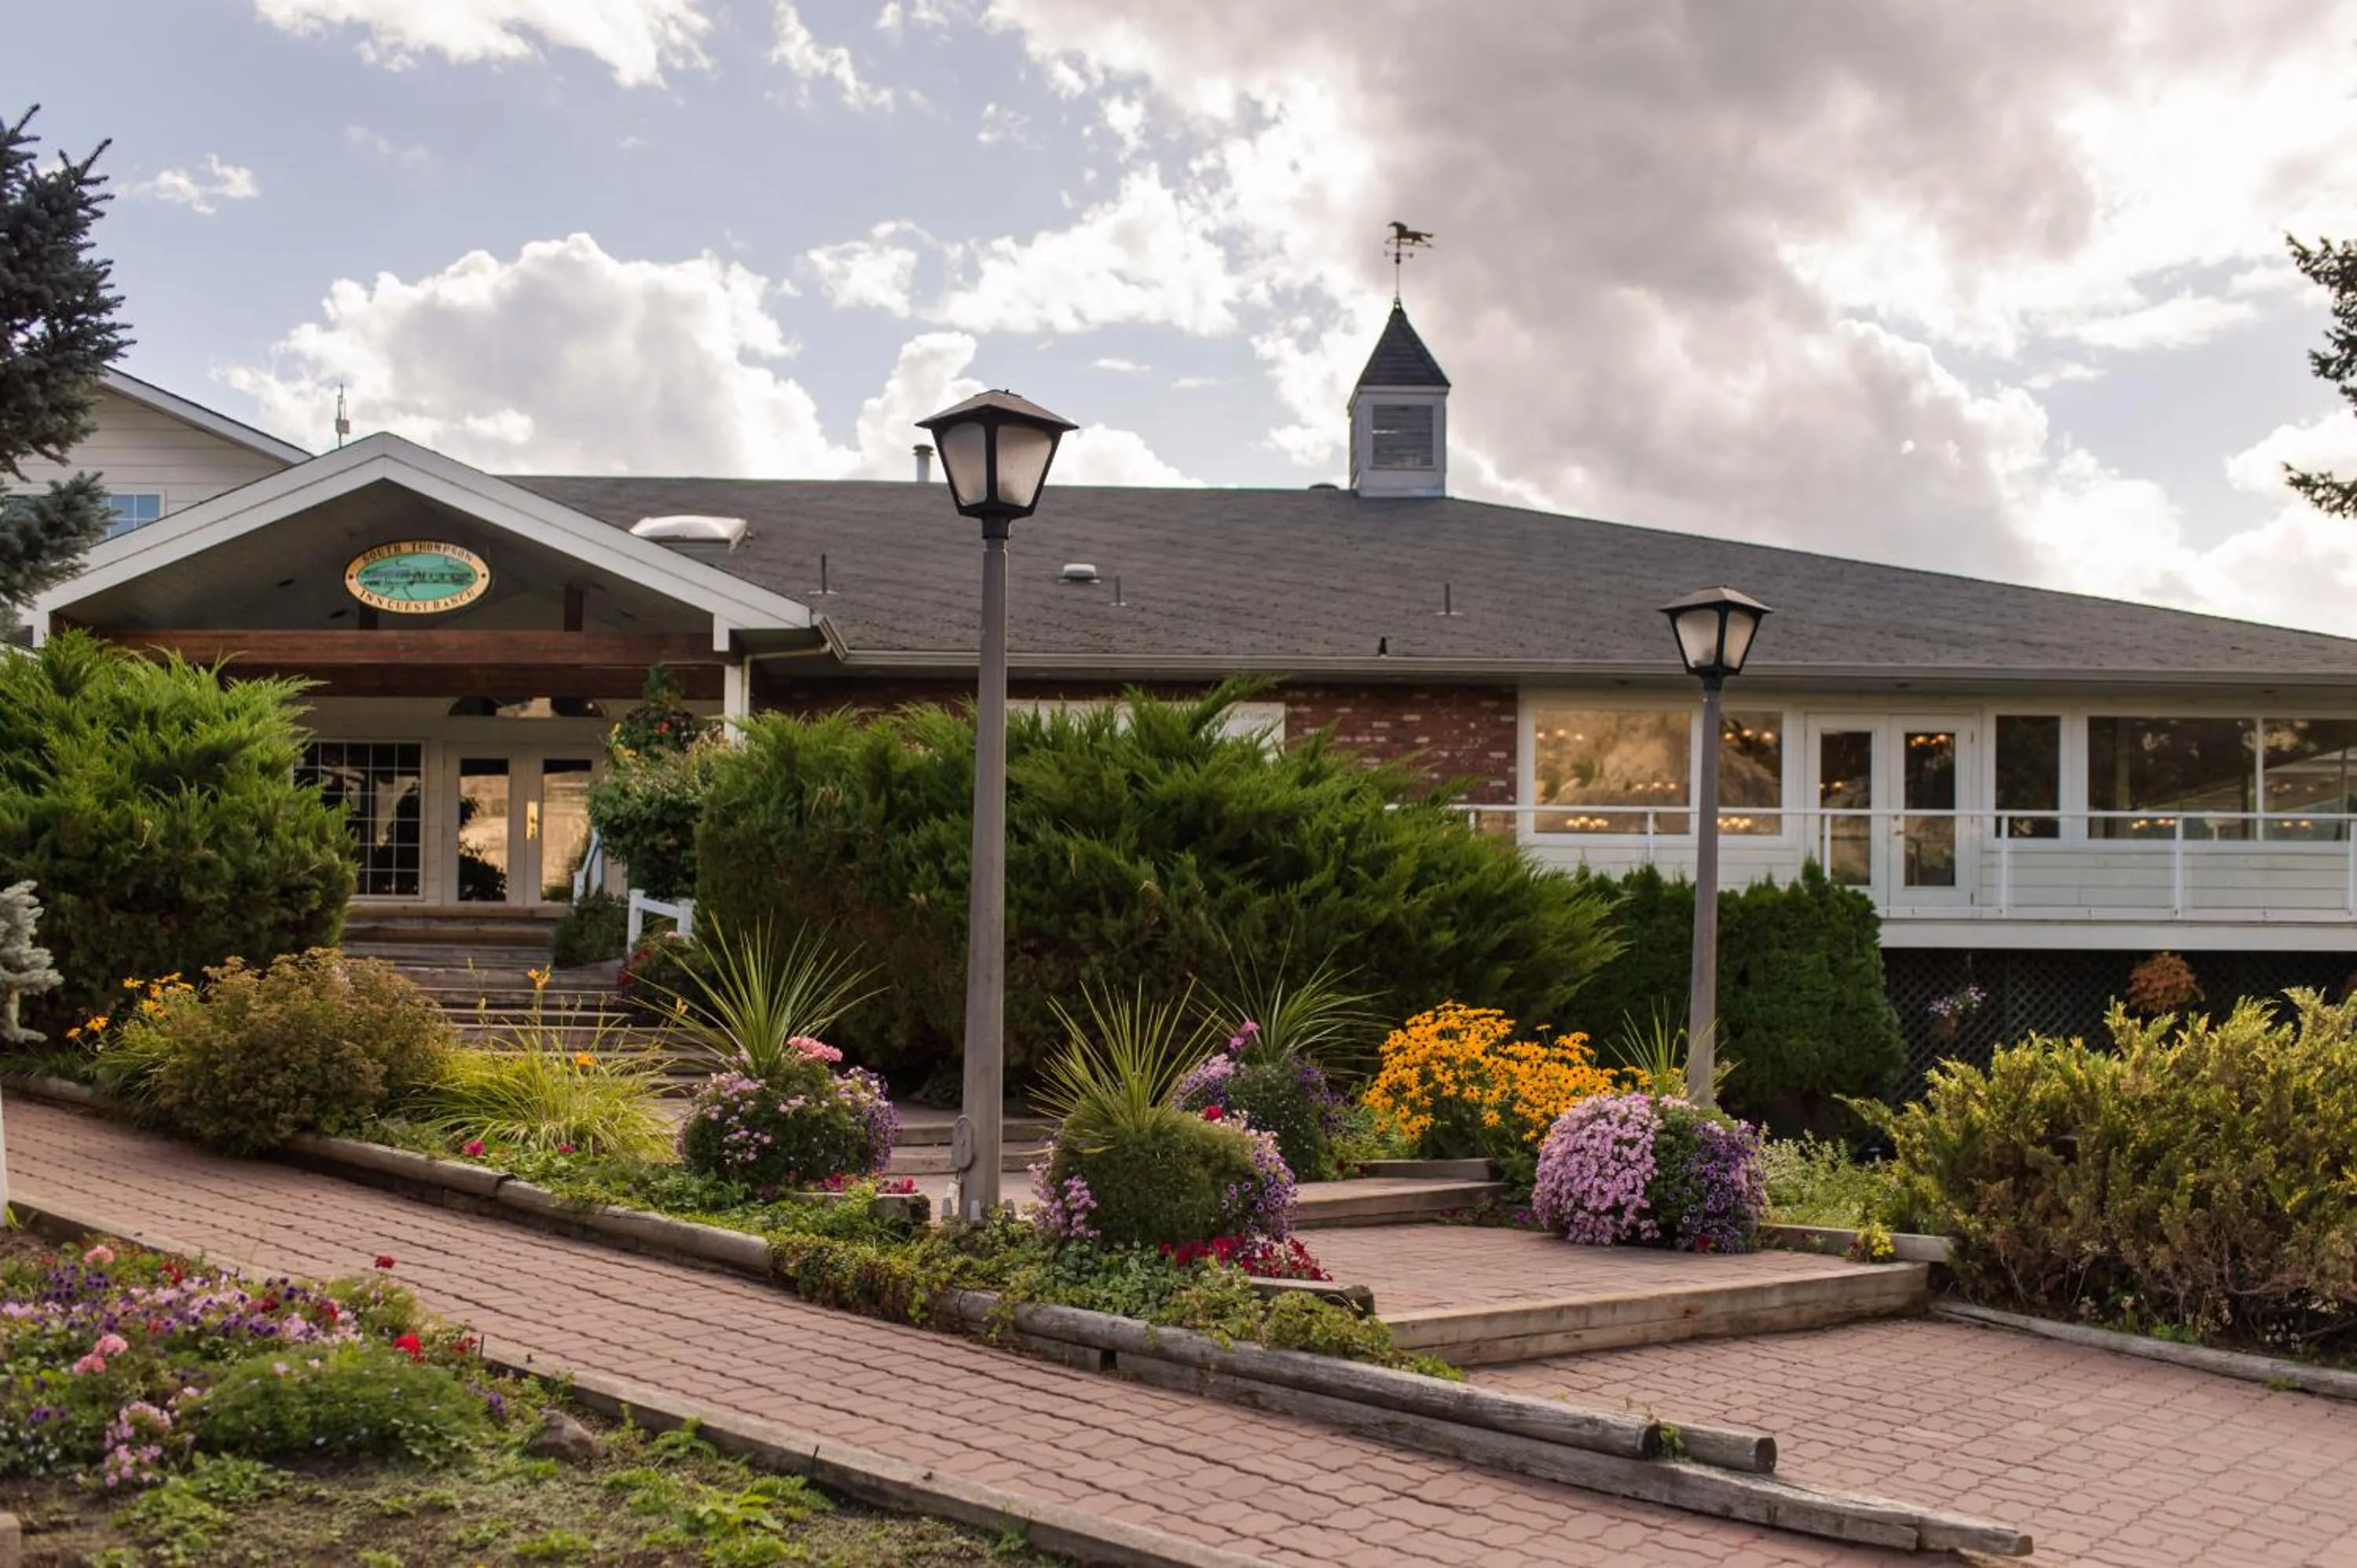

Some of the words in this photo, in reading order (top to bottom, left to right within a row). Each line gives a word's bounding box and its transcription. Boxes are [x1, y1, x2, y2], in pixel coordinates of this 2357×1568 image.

[362, 543, 401, 563] SOUTH
[412, 542, 473, 562] THOMPSON
[359, 590, 383, 606] INN
[387, 601, 429, 610] GUEST
[433, 589, 475, 610] RANCH
